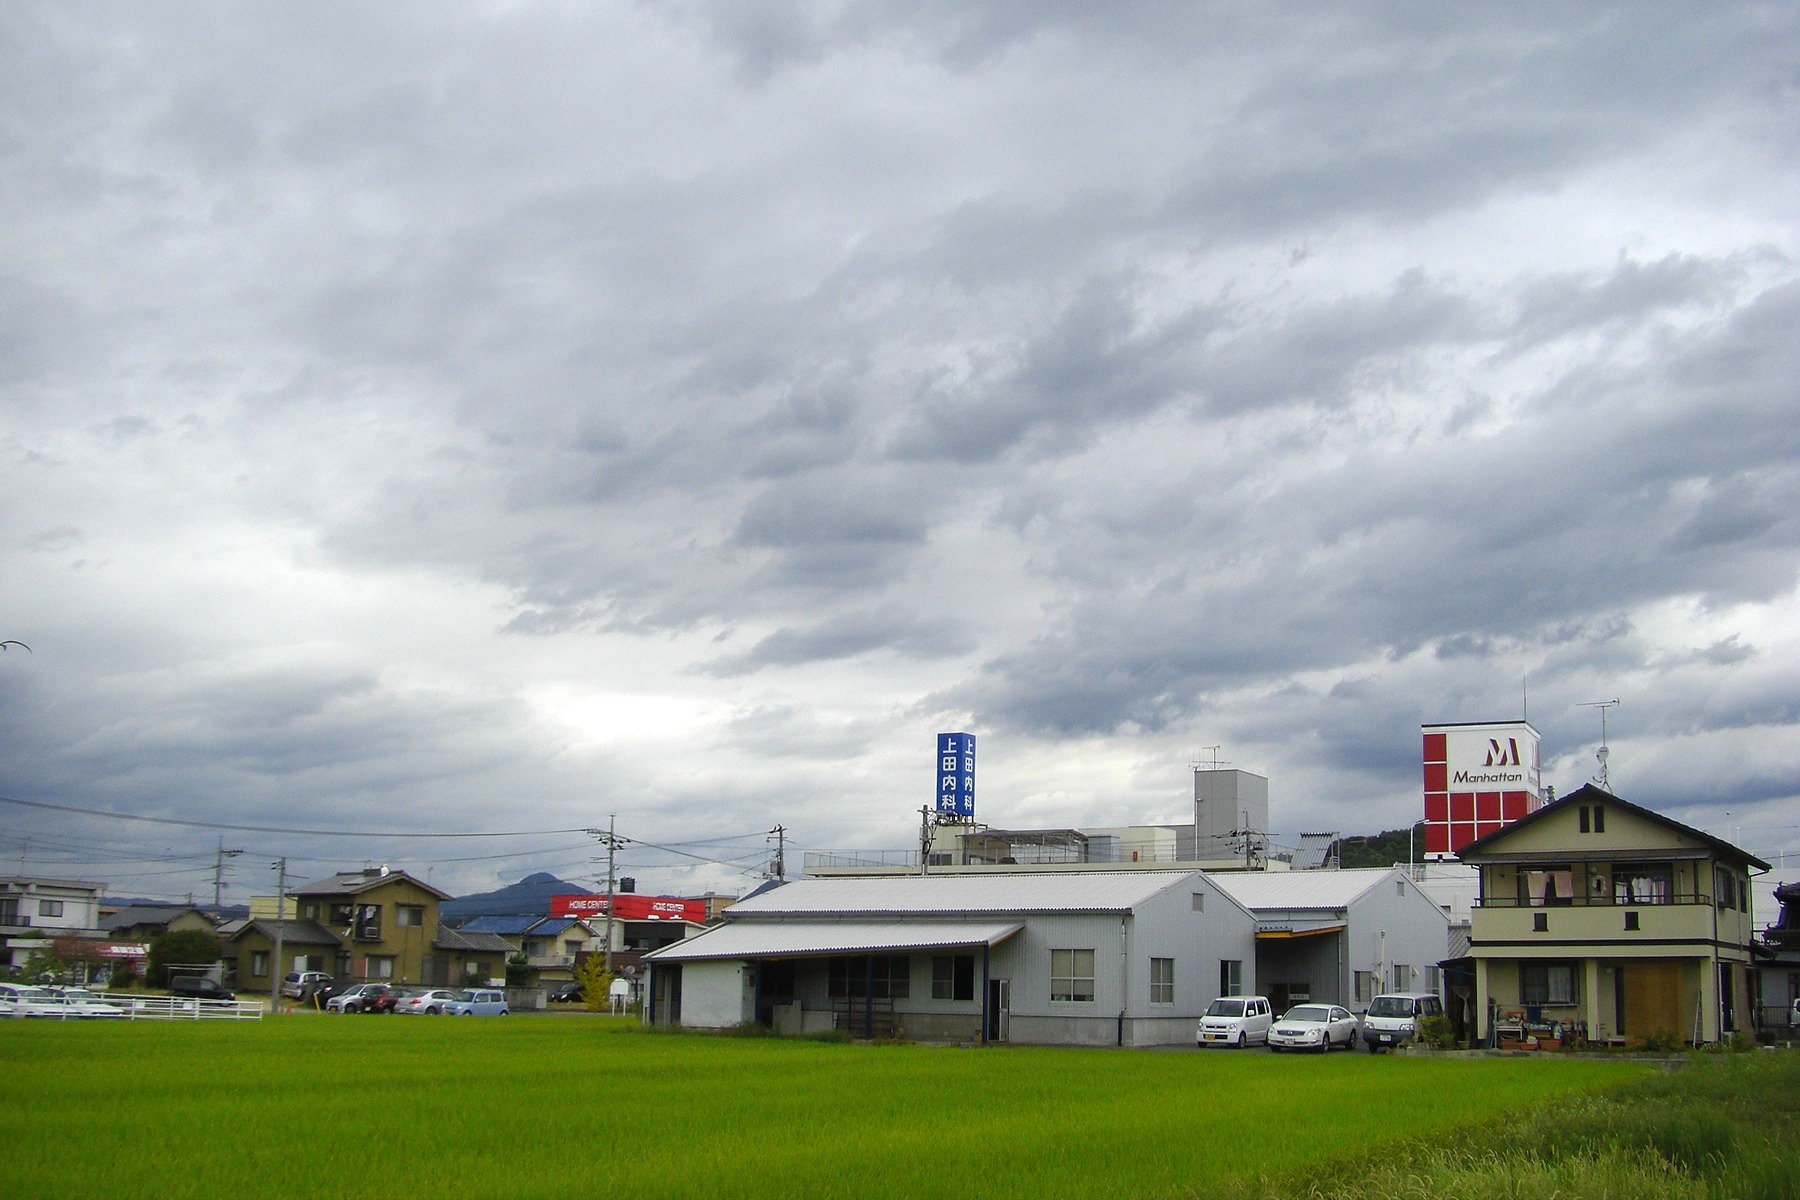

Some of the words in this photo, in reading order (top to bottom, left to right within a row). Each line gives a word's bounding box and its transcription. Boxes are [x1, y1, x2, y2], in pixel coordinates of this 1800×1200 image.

[942, 738, 957, 810] 上田内科
[964, 739, 973, 811] 上田内科
[1453, 771, 1522, 783] Manhattan
[569, 900, 587, 909] HOME
[588, 900, 609, 909] CENTE
[652, 902, 666, 911] HOME
[666, 903, 684, 912] CENTER
